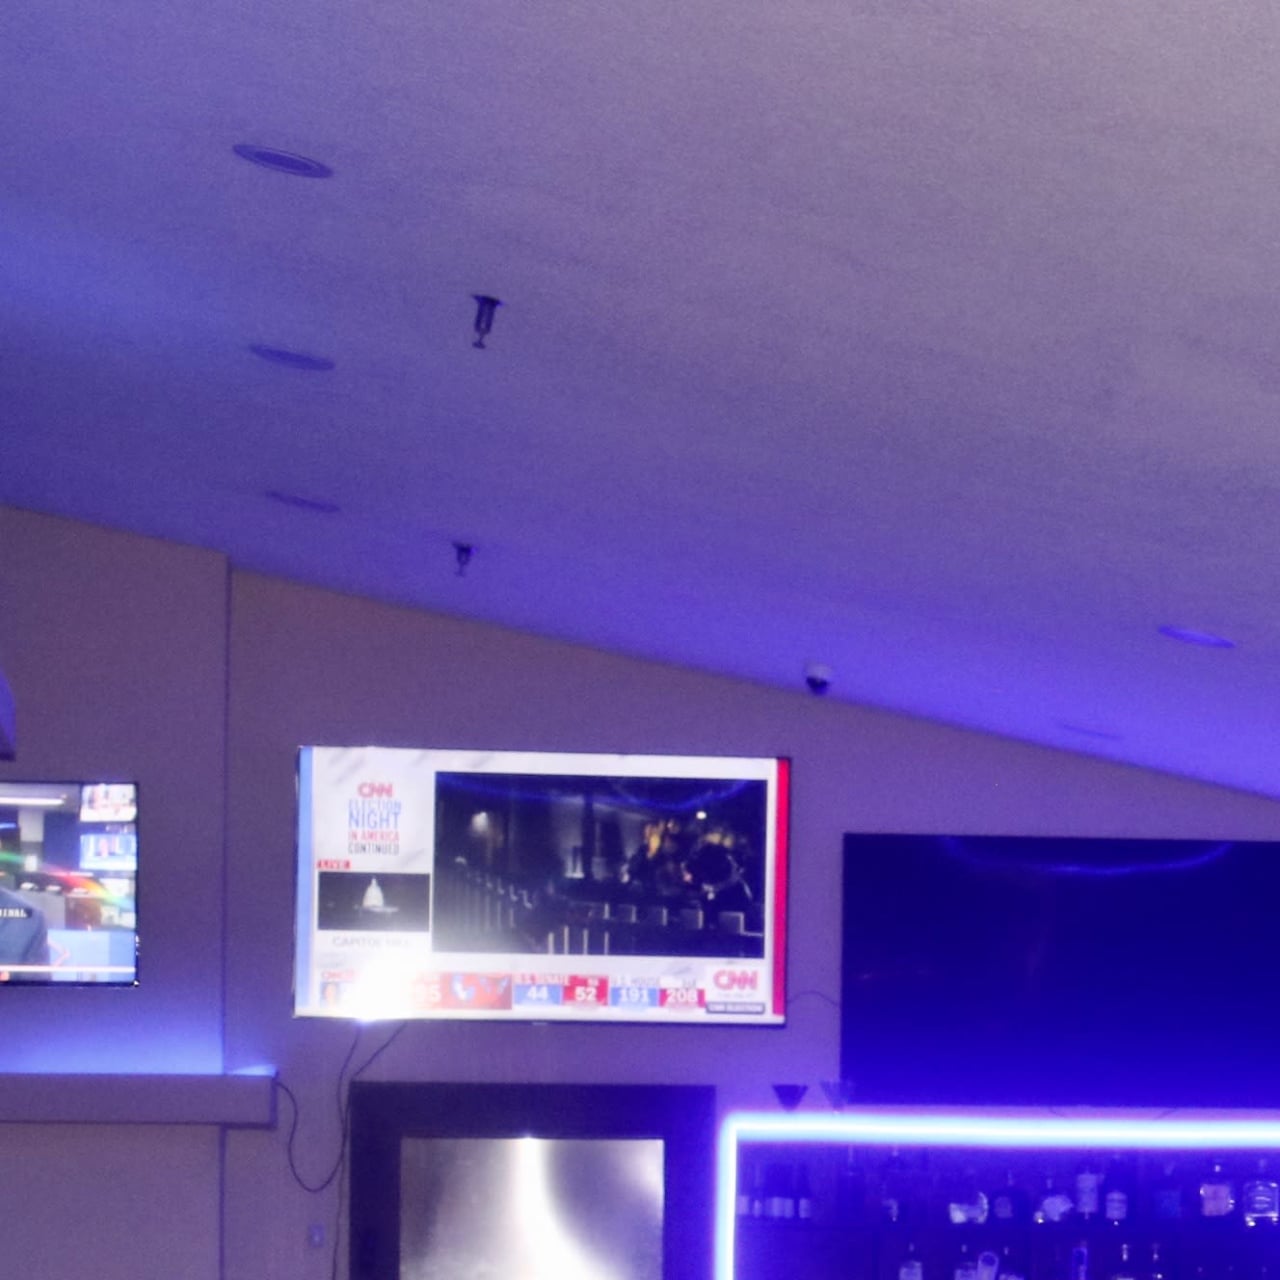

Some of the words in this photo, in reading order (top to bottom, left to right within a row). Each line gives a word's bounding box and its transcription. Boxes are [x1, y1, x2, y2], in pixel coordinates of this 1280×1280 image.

[357, 782, 394, 799] CNN
[348, 810, 401, 829] NIGHT
[347, 842, 400, 855] CONTINUED
[713, 969, 759, 990] CNN
[527, 986, 549, 1001] 44
[575, 986, 597, 1001] 52
[619, 988, 649, 1002] 191
